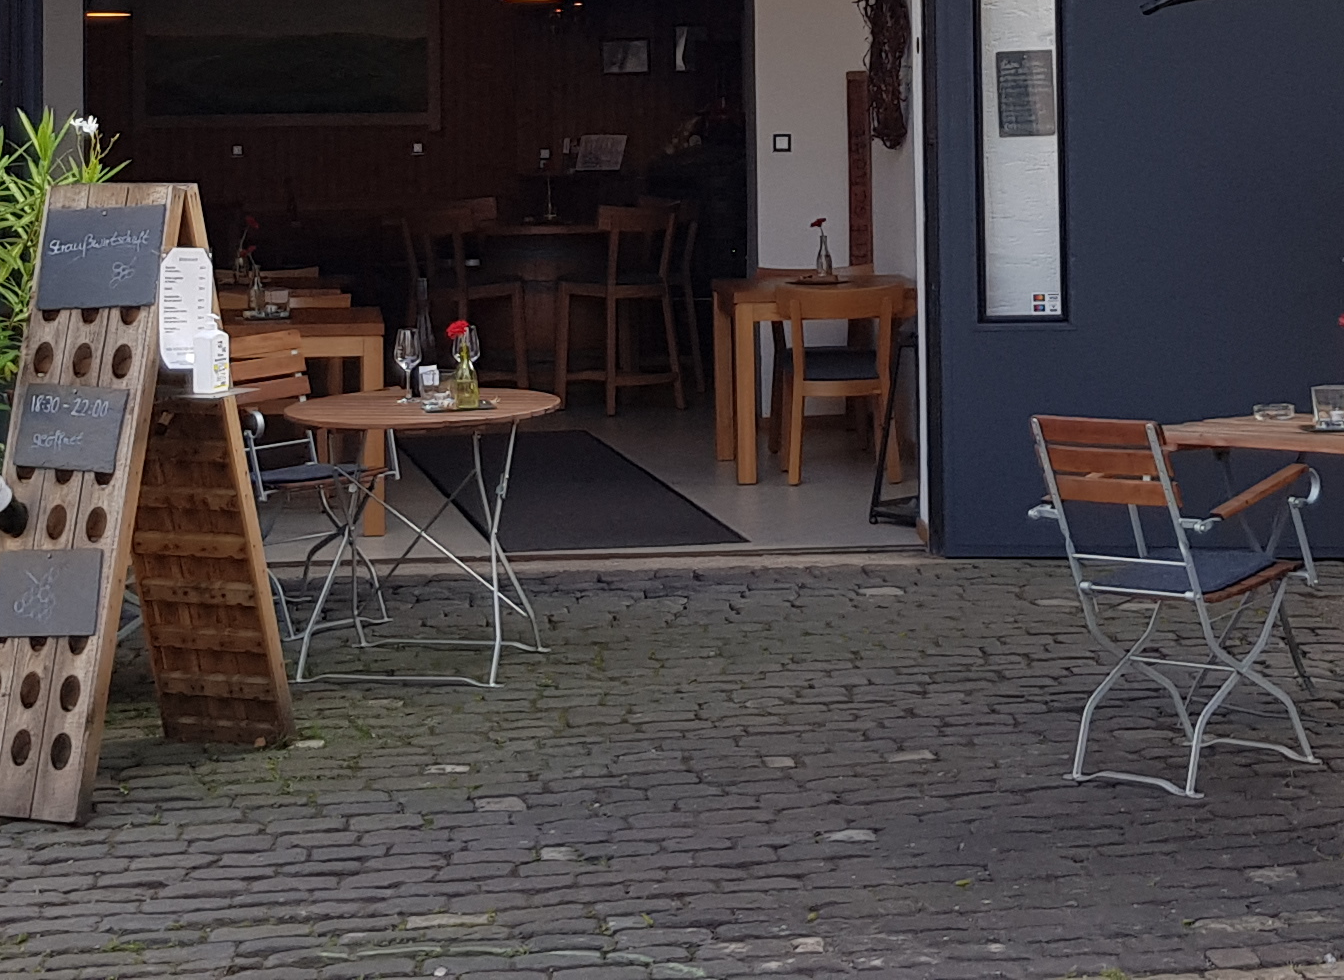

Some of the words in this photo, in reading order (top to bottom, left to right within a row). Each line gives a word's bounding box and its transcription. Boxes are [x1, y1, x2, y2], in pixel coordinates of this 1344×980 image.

[48, 229, 150, 258] Straußwirtschaft
[70, 397, 110, 418] 22:00
[30, 429, 85, 453] geöffnet
